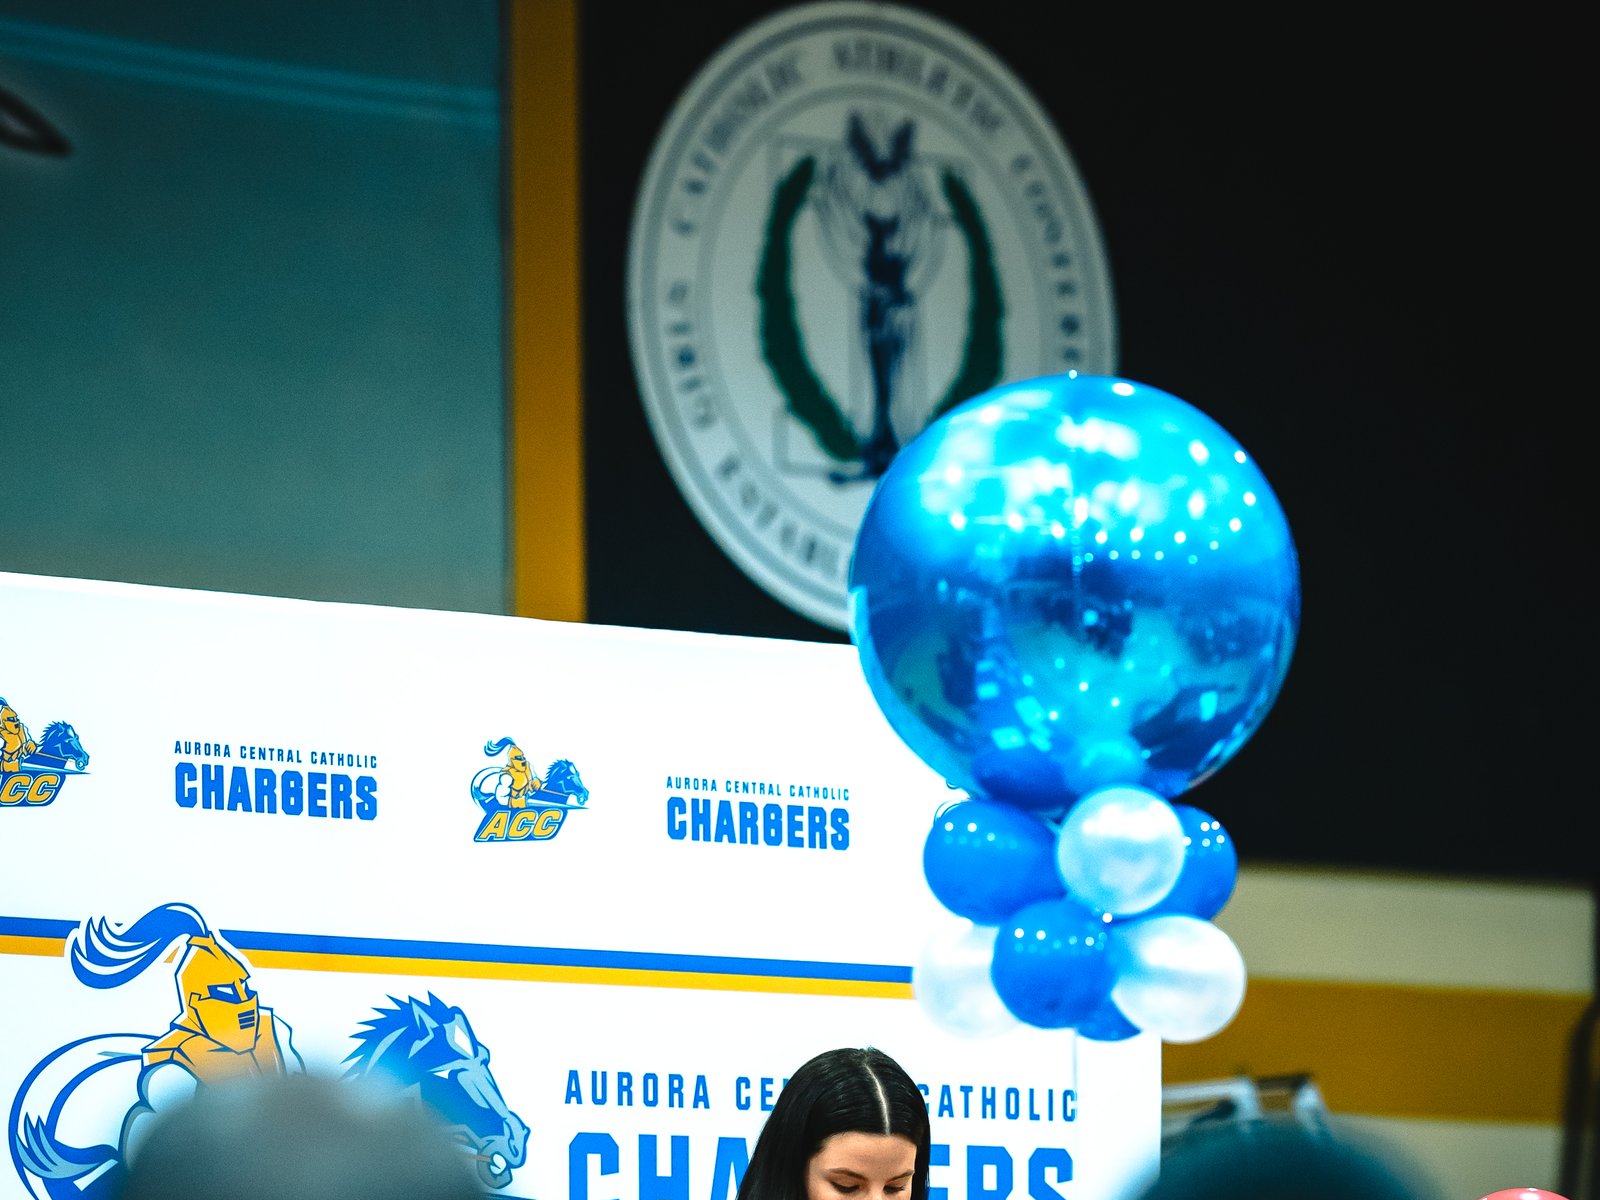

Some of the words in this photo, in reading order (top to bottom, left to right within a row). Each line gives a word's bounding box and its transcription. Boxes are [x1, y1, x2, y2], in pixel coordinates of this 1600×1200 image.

[174, 740, 231, 758] AURORA
[239, 745, 302, 764] CENTRAL
[310, 750, 378, 769] CATHOLIC
[0, 772, 60, 804] CC
[174, 761, 378, 821] CHARGERS
[666, 776, 718, 792] AURORA
[725, 780, 782, 796] CENTRAL
[788, 784, 850, 801] CATHOLIC
[477, 808, 564, 842] ACC
[666, 796, 850, 851] CHARGERS
[564, 1069, 710, 1110] AURORA
